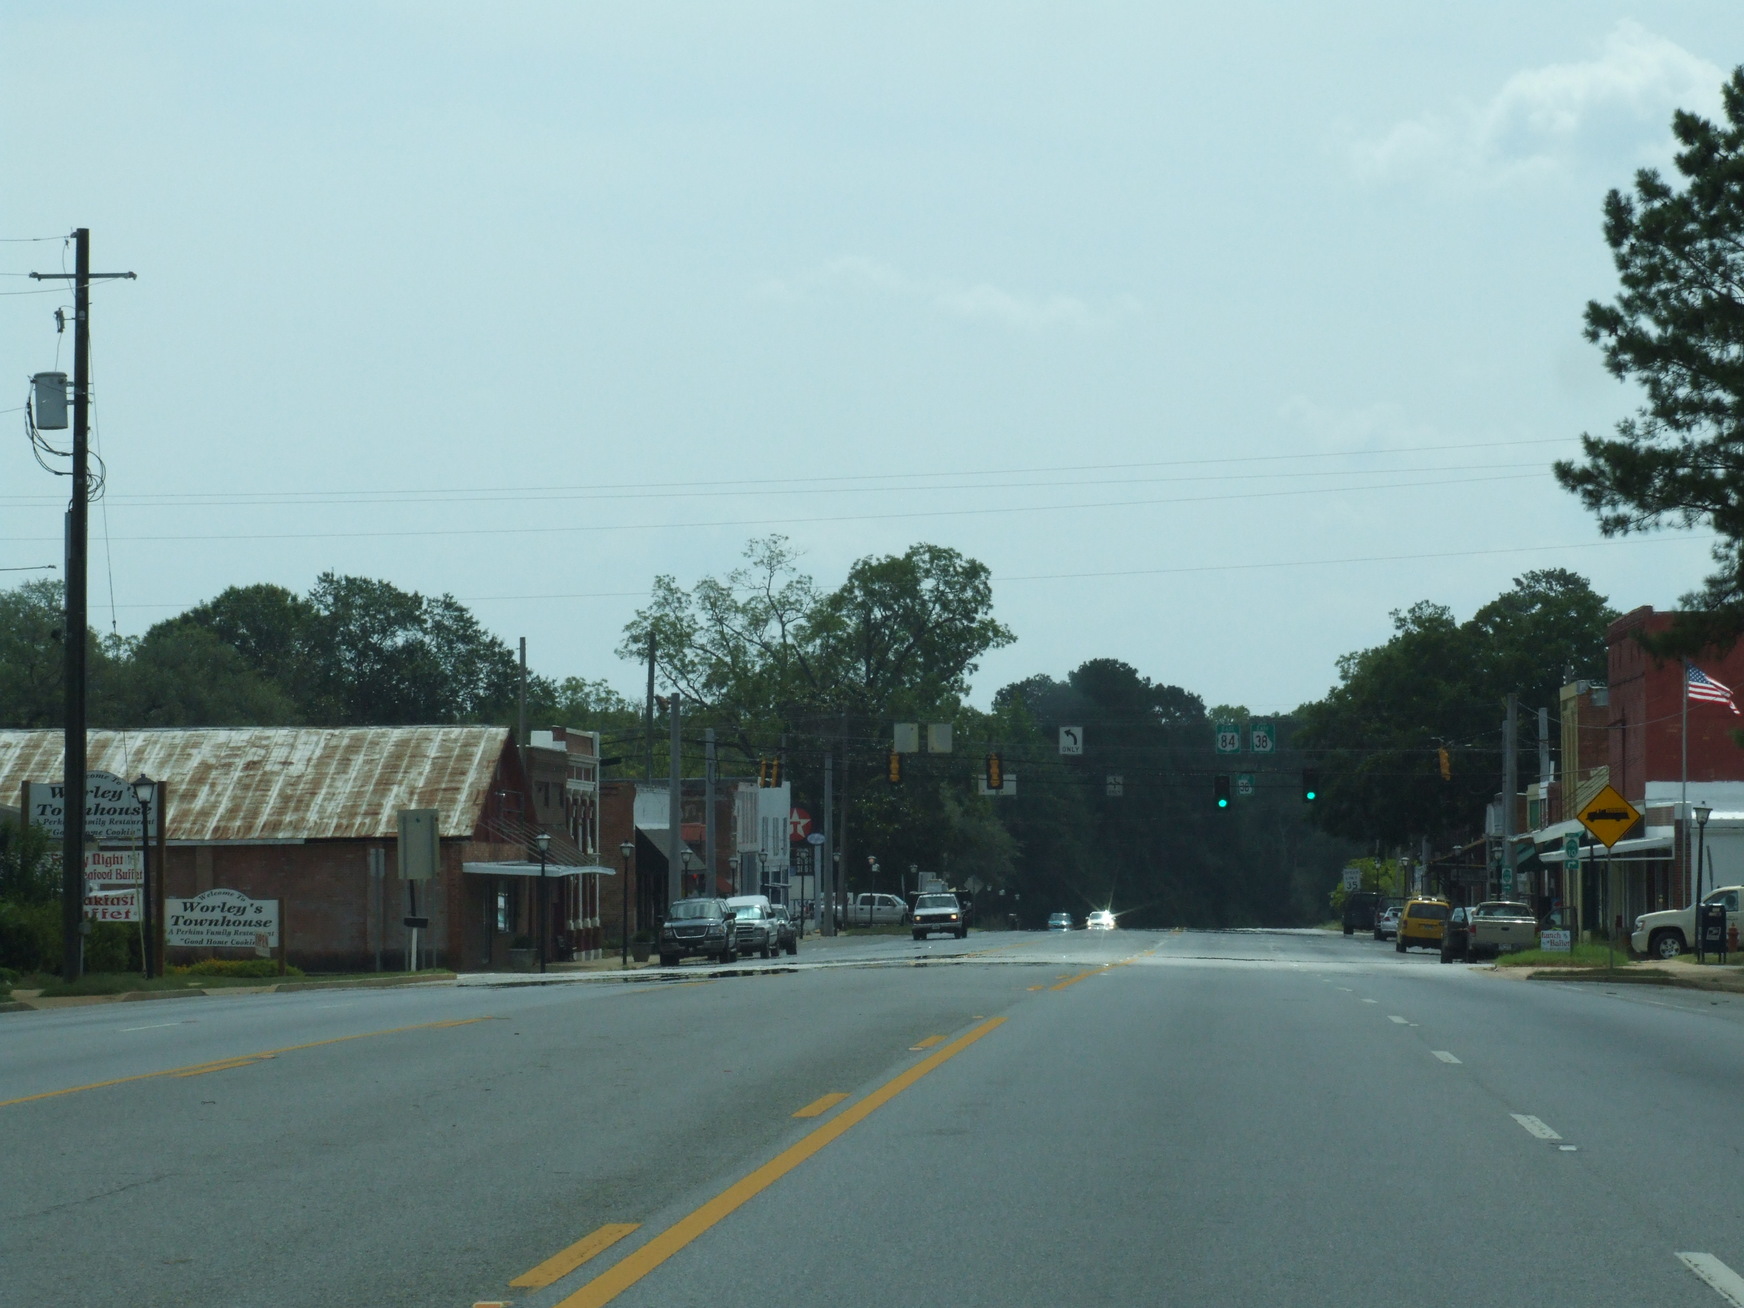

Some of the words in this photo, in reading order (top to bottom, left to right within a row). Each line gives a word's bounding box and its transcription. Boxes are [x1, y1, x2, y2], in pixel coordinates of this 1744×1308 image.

[1221, 734, 1235, 748] 84
[1255, 734, 1268, 748] 38
[92, 853, 123, 868] Night
[84, 868, 112, 880] eafood
[115, 868, 143, 880] Buffet
[1347, 881, 1358, 889] 35
[199, 890, 234, 902] Welcome
[237, 893, 246, 902] To
[182, 901, 263, 916] Worley's
[170, 915, 273, 928] Townhouse
[176, 928, 204, 936] Perkins
[206, 928, 232, 937] Family
[206, 938, 228, 946] Home
